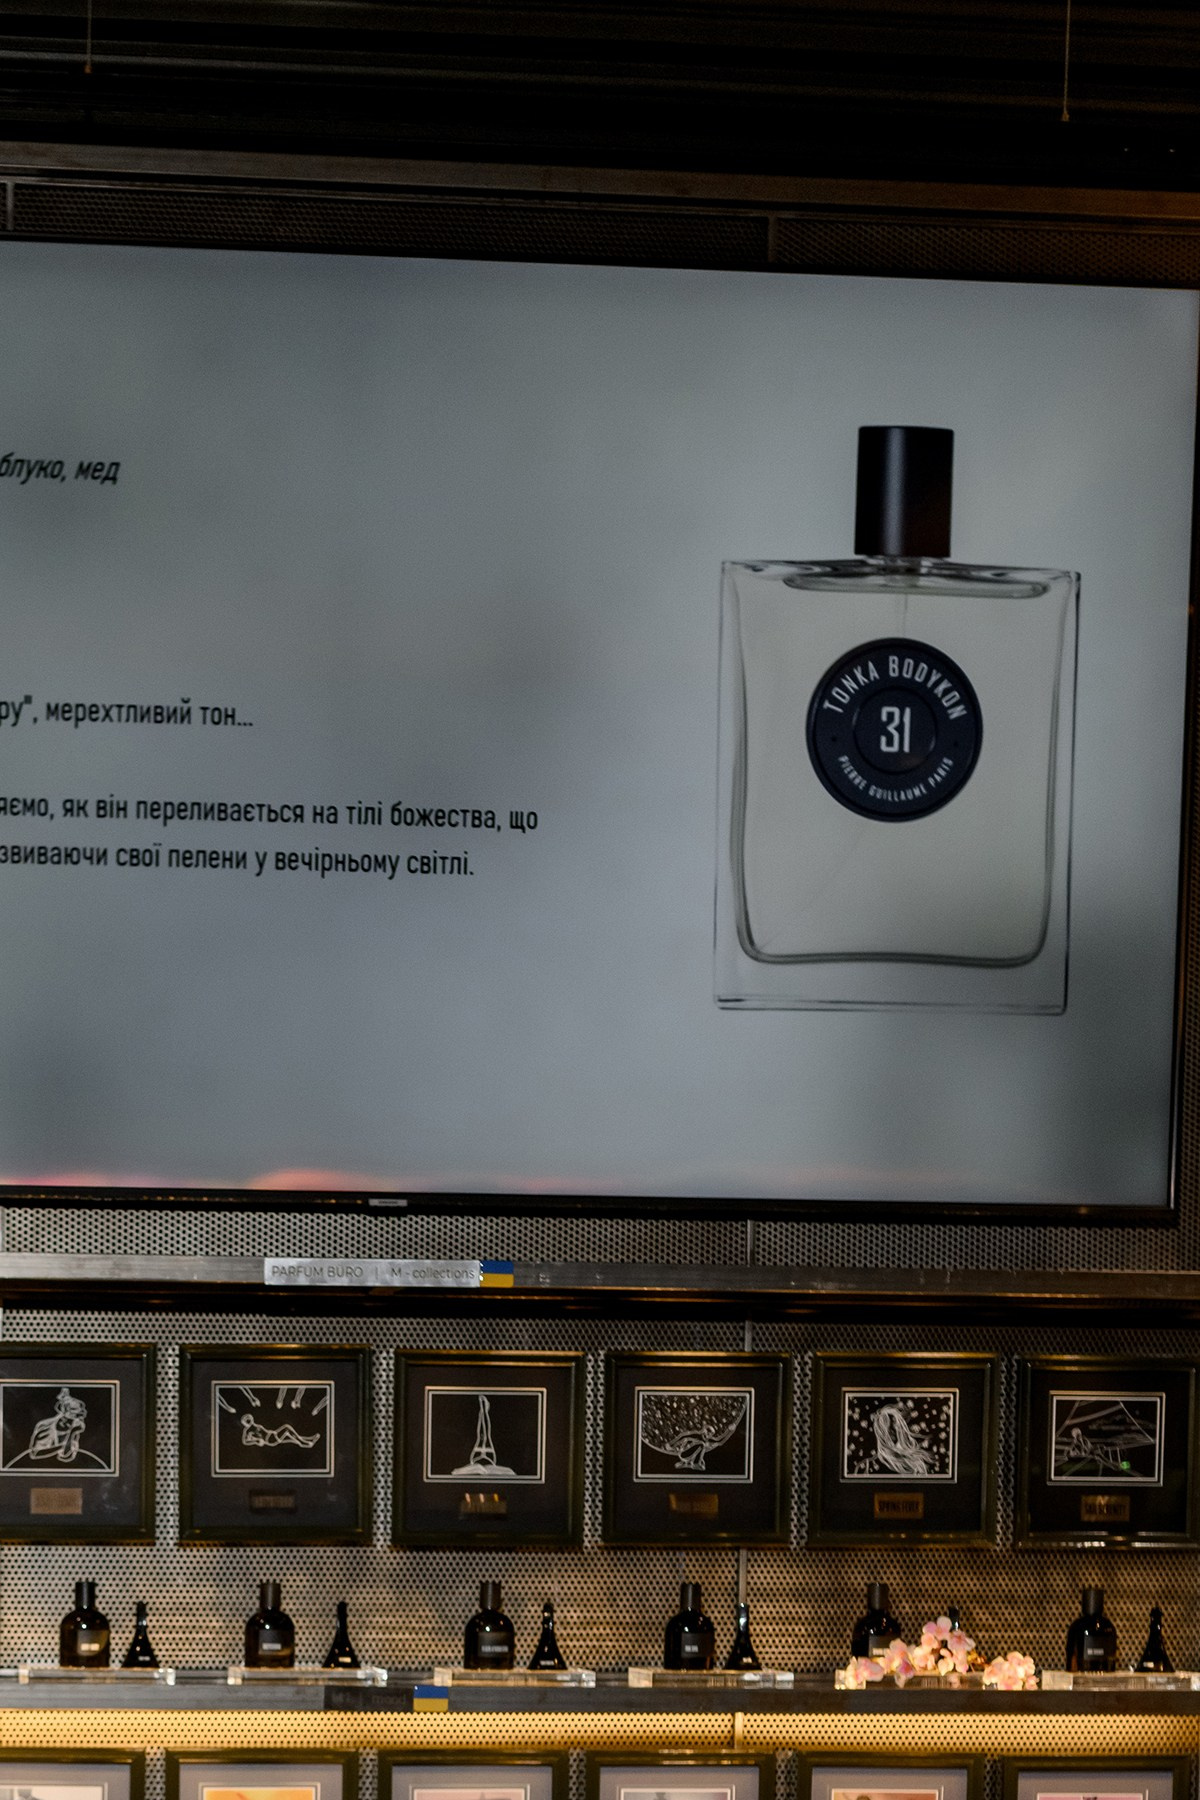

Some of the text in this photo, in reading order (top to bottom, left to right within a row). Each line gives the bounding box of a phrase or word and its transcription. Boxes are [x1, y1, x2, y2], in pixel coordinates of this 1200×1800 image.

[73, 460, 122, 486] мед
[822, 655, 968, 720] TONKA BODYKON
[45, 697, 192, 730] мерехтливий
[880, 705, 912, 754] 31
[838, 754, 868, 791] PIERRE
[928, 756, 955, 788] PARIS
[61, 798, 90, 819] як
[95, 793, 129, 819] він
[135, 799, 305, 828] переливається
[311, 804, 339, 825] на
[345, 799, 383, 826] тілі
[389, 799, 502, 833] божества,
[508, 810, 539, 835] що
[115, 842, 163, 868] свої
[167, 848, 248, 870] пелени
[254, 850, 268, 878] у
[274, 846, 401, 881] вечірньому
[406, 849, 475, 876] світлі.
[271, 1265, 324, 1279] PARFUM
[412, 1267, 476, 1281] collections
